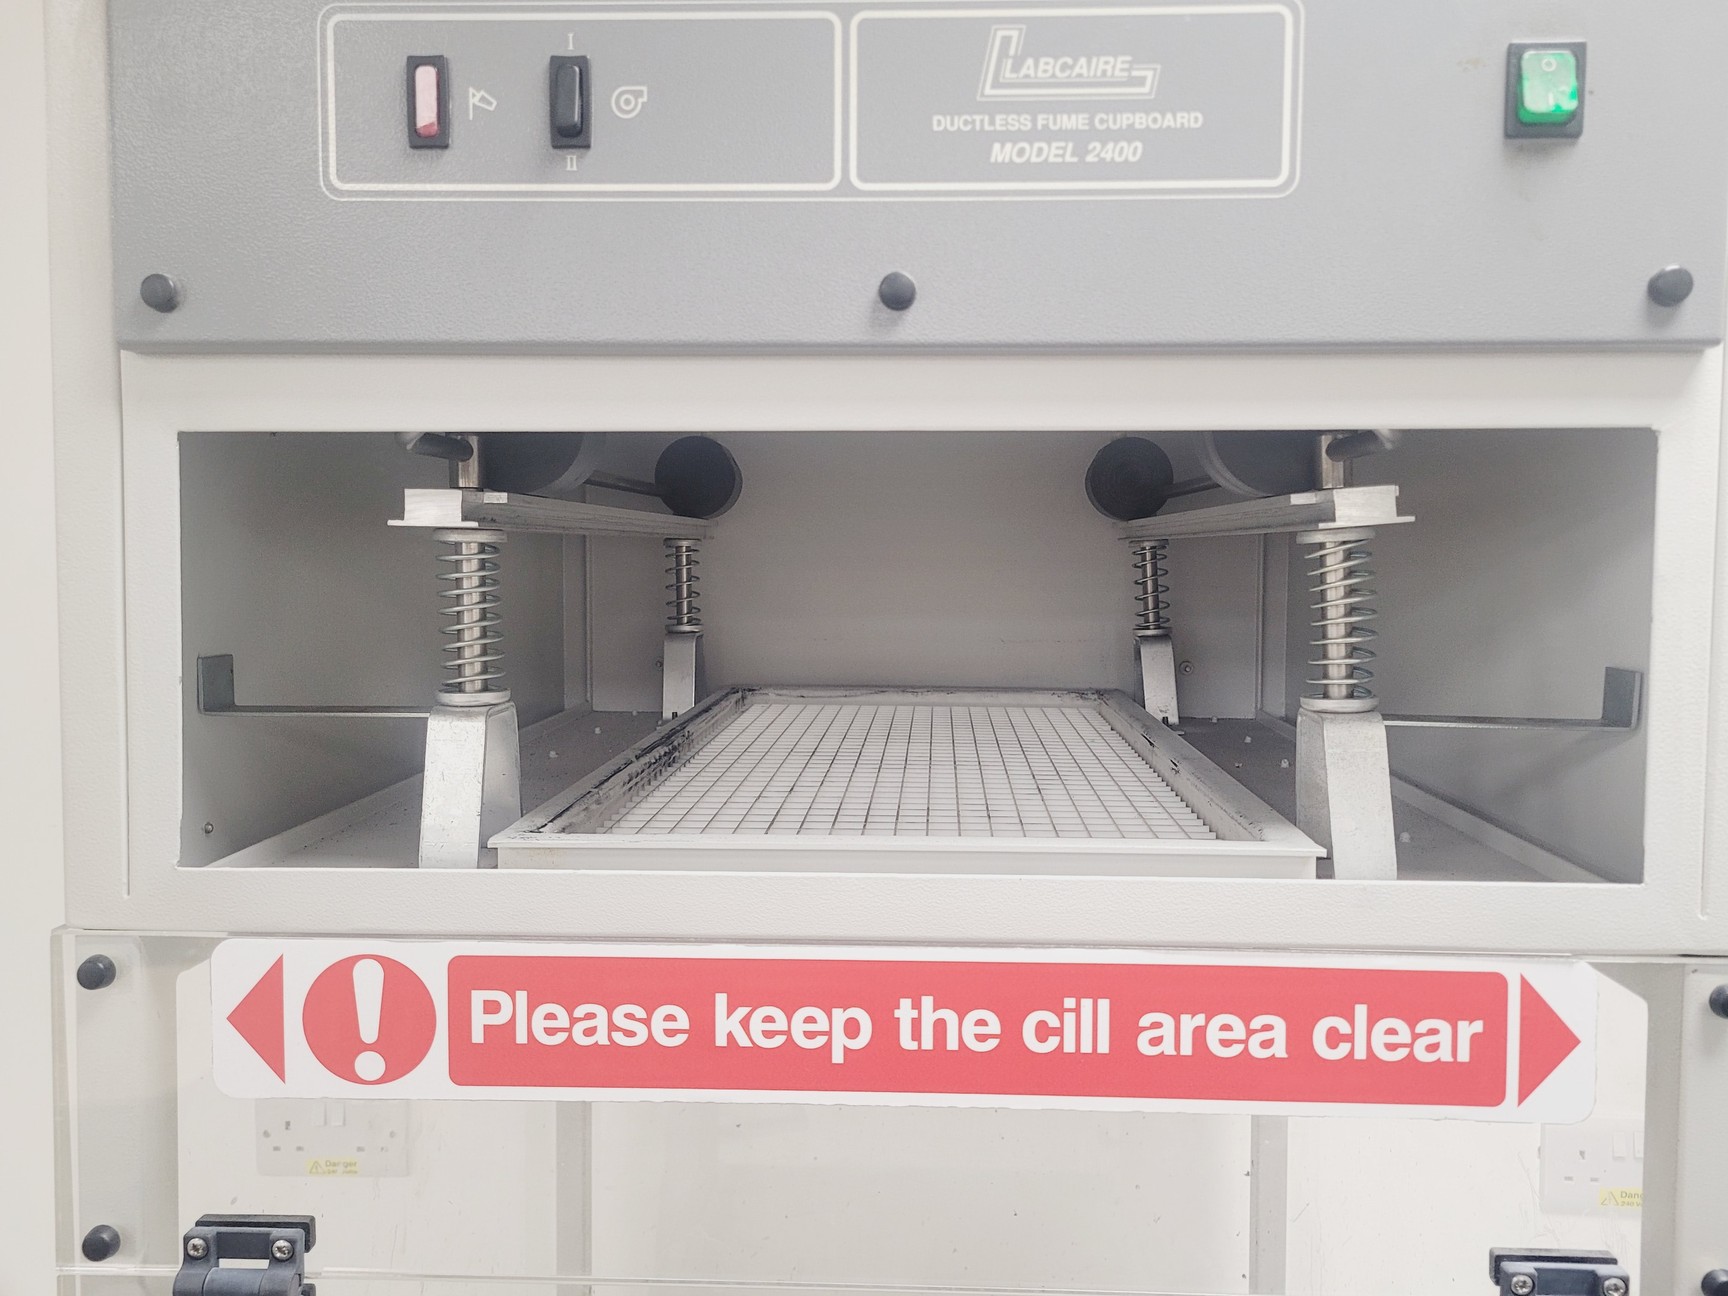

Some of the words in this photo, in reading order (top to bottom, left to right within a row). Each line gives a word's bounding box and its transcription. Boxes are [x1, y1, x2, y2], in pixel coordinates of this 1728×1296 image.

[1003, 56, 1132, 79] LABCAIRE
[932, 114, 1032, 132] DUCTLESS
[1037, 113, 1089, 130] FUME
[1095, 111, 1204, 129] CUPBOARD
[990, 142, 1079, 164] MODEL
[1085, 141, 1143, 163] 2400
[471, 990, 689, 1047] Please
[715, 993, 872, 1064] keep
[894, 996, 1000, 1052] the
[1023, 998, 1109, 1053] cill
[1138, 1013, 1287, 1058] area
[1313, 1004, 1484, 1062] clear
